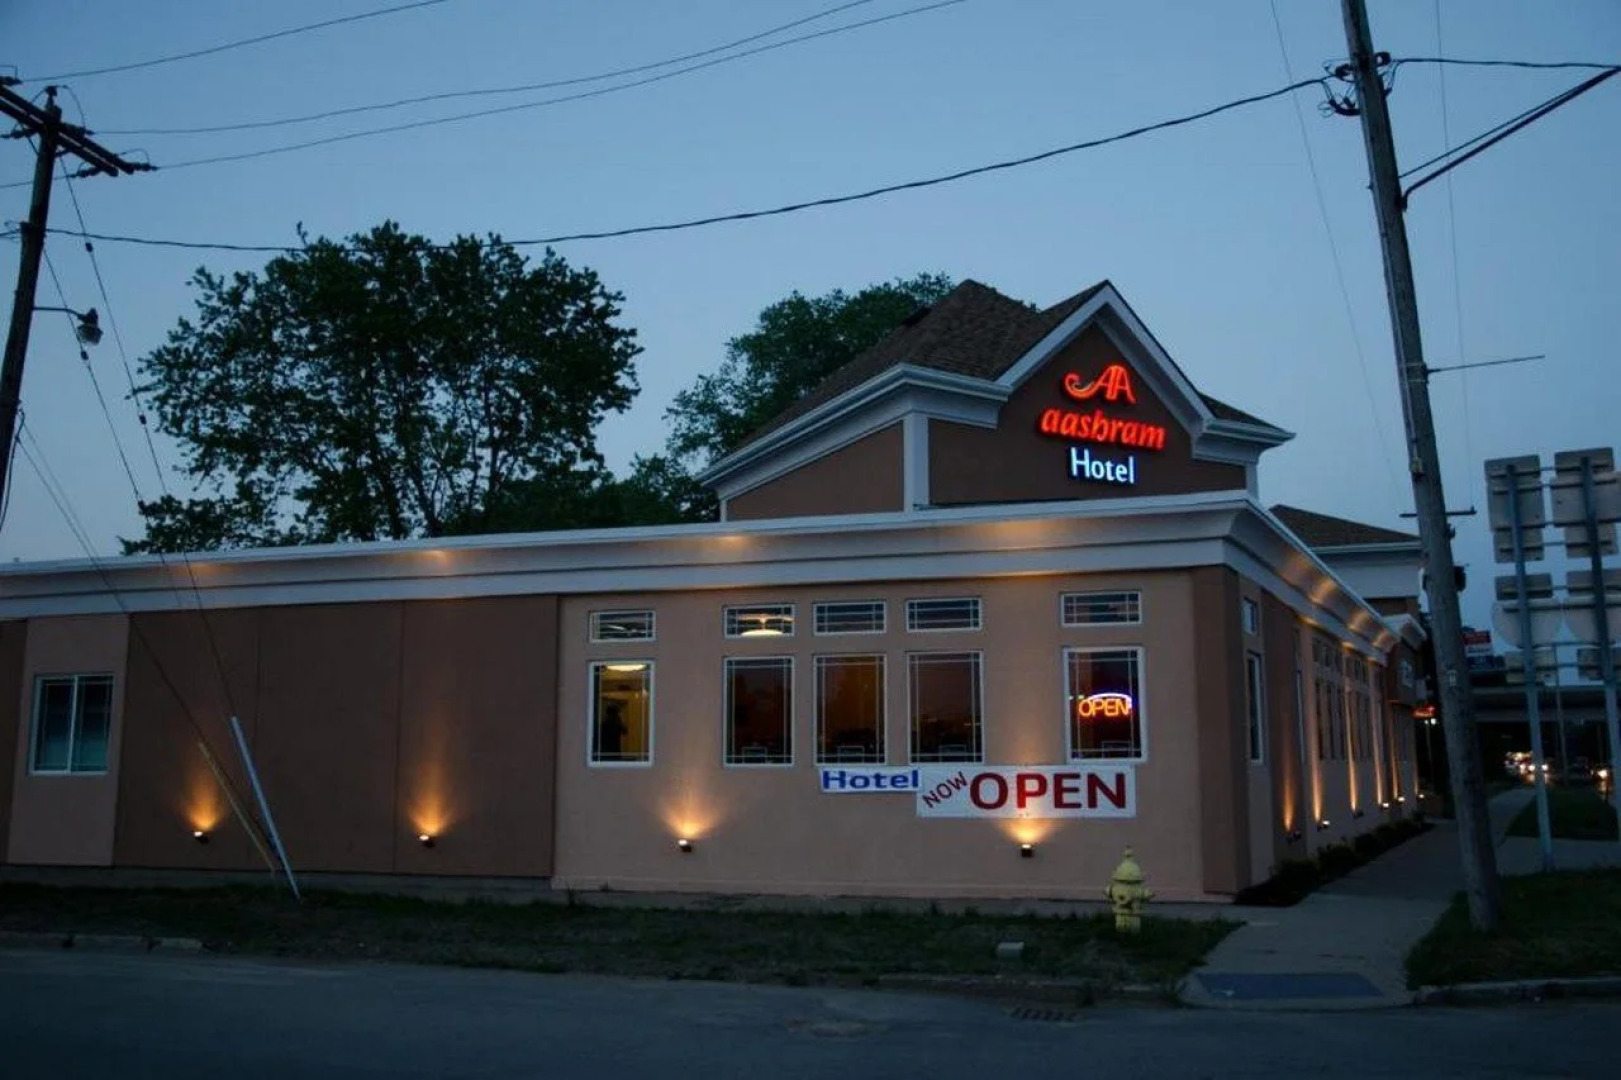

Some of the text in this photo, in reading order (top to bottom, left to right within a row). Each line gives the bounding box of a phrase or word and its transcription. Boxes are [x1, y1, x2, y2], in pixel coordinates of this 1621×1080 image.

[1070, 447, 1135, 484] Hotel
[1079, 698, 1129, 717] OPEN
[822, 769, 919, 790] Hotel
[922, 771, 1127, 811] NOW OPEN
